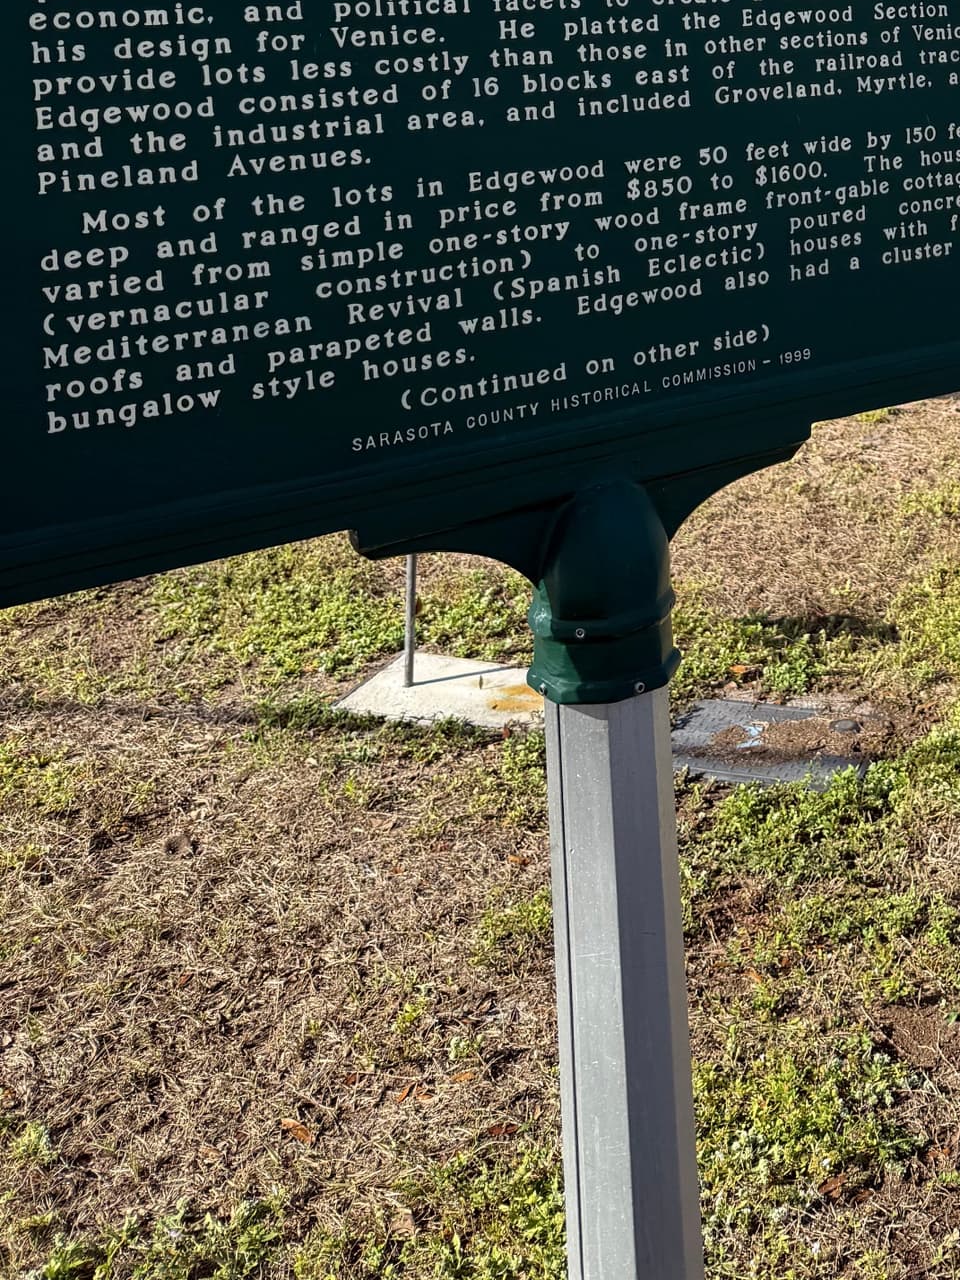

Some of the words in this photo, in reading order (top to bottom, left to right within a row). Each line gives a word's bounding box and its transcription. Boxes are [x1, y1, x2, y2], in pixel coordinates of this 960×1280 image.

[31, 39, 86, 64] his
[113, 34, 232, 62] design
[256, 30, 305, 53] for
[329, 24, 445, 49] Venice.
[498, 19, 535, 40] He
[563, 13, 660, 41] platted
[681, 11, 721, 31] the
[742, 5, 853, 31] Edgewood
[873, 1, 948, 20] Section
[35, 96, 215, 133] Edgewood
[238, 83, 399, 115] consisted
[421, 78, 452, 101] of
[472, 76, 499, 98] 16
[522, 70, 612, 94] blocks
[635, 64, 690, 86] east
[712, 60, 736, 80] of
[759, 57, 794, 76] the
[815, 50, 903, 73] railroad
[37, 135, 104, 162] and
[129, 130, 187, 154] the
[213, 113, 385, 147] industrial
[407, 110, 485, 131] area,
[506, 100, 556, 122] and
[577, 89, 691, 117] included
[714, 78, 842, 105] Groveland,
[856, 72, 932, 95] Myrtle,
[37, 159, 198, 195] Pineland
[226, 148, 371, 177] Avenues.
[40, 246, 129, 272] deep
[156, 231, 218, 259] and
[241, 215, 361, 249] ranged
[384, 210, 413, 232] in
[439, 200, 517, 229] price
[539, 191, 603, 212] from
[626, 175, 693, 201] $850
[710, 172, 734, 191] to
[755, 160, 828, 187] $1600.
[863, 154, 903, 173] The
[82, 205, 166, 234] Most
[192, 197, 226, 223] of
[251, 193, 305, 216] the
[332, 183, 393, 208] lots
[416, 177, 444, 198] in
[468, 159, 605, 193] Edgewood
[624, 155, 682, 174] were
[699, 145, 728, 166] 50
[745, 140, 789, 162] feet
[803, 135, 852, 155] wide
[866, 131, 892, 151] by
[906, 125, 937, 145] 150
[41, 269, 164, 304] varied
[191, 260, 271, 286] from
[300, 241, 404, 271] simple
[428, 221, 570, 254] one-story
[594, 206, 660, 231] wood
[678, 198, 747, 221] frame
[765, 178, 890, 209] front-gable
[43, 290, 269, 336] (vernacular
[315, 249, 532, 299] construction)
[574, 243, 600, 262] to
[634, 222, 758, 252] one-story
[789, 204, 866, 235] poured
[42, 315, 313, 369] Mediterranean
[347, 287, 463, 325] Revival
[493, 265, 621, 301] (Spanish
[647, 242, 765, 278] Eclectic)
[790, 232, 862, 256] houses
[883, 219, 928, 241] with
[47, 389, 221, 434] bungalow
[252, 369, 335, 400] style
[362, 348, 475, 381] houses.
[352, 420, 454, 451] SARASOTA
[466, 402, 539, 429] COUNTY
[551, 380, 651, 412] HISTORICAL
[662, 359, 756, 388] COMMISSION
[779, 348, 811, 364] 1999
[401, 362, 567, 410] (Continued
[585, 358, 615, 375] on
[633, 340, 700, 366] other
[713, 324, 770, 351] side)
